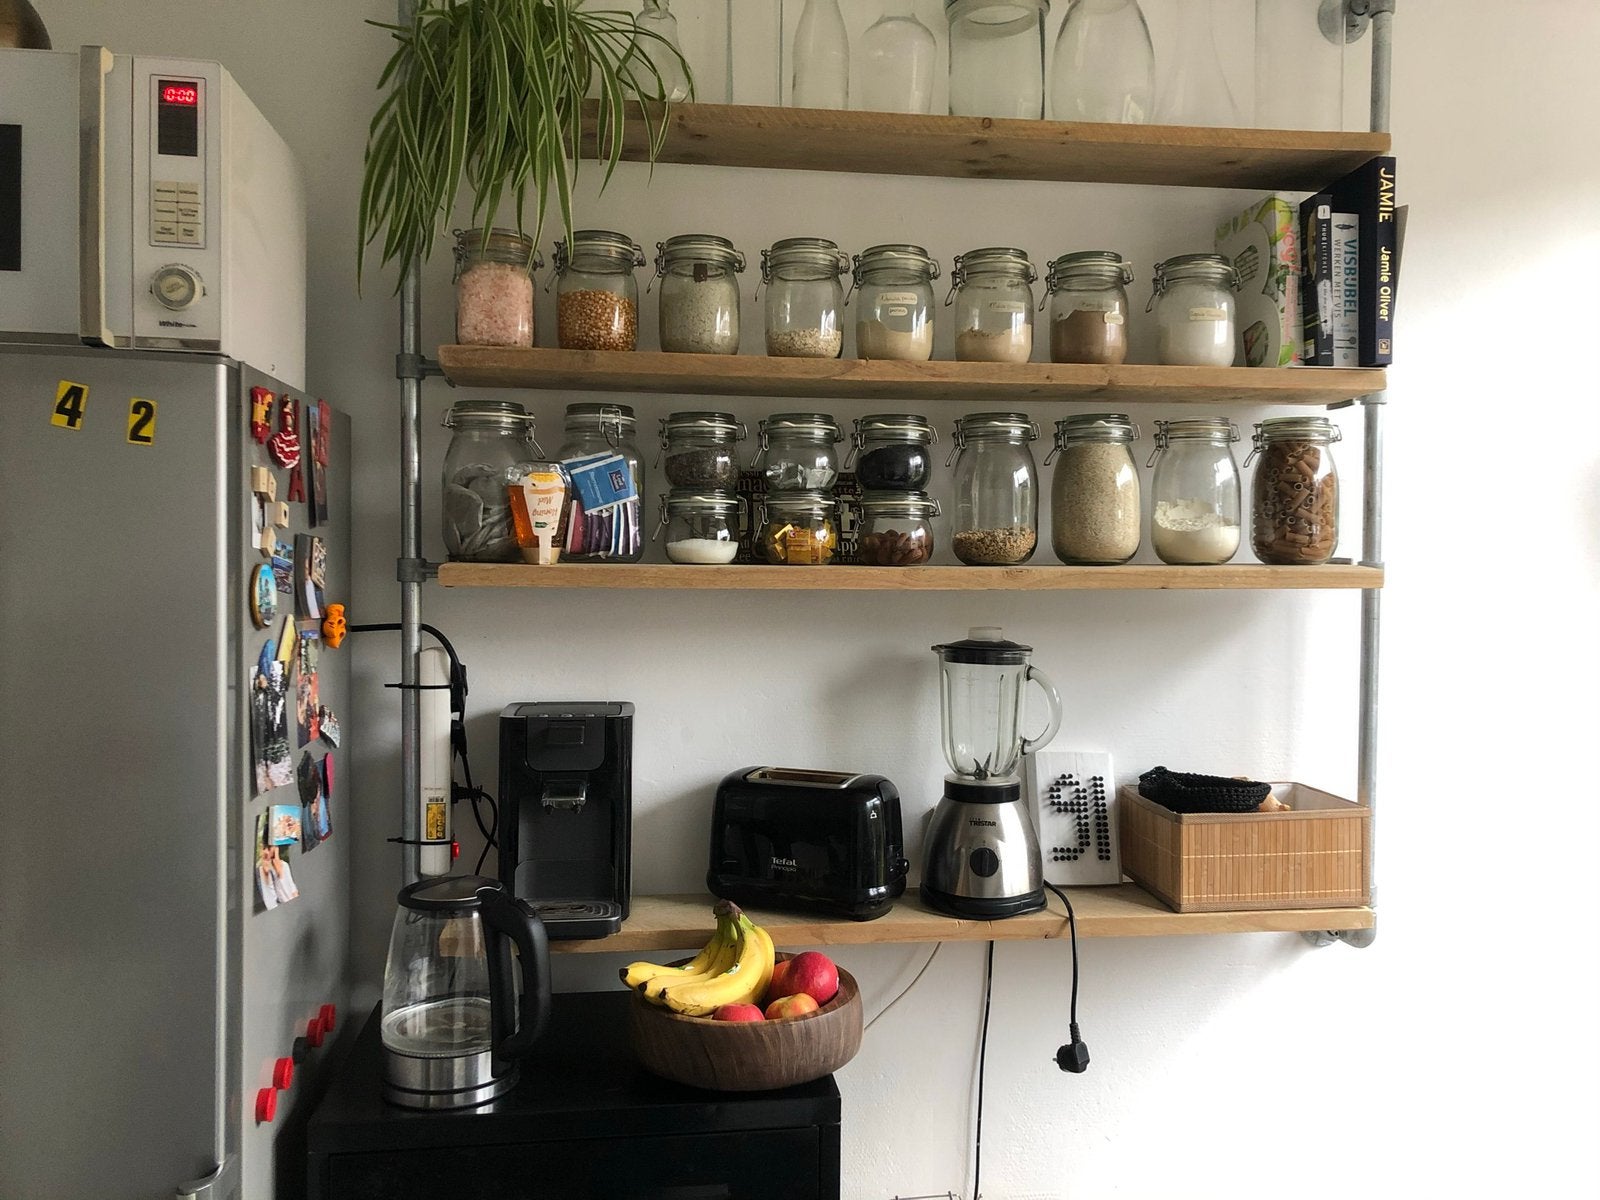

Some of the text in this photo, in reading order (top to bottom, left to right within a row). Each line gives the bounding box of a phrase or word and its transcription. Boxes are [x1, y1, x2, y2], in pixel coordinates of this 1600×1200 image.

[1378, 167, 1394, 223] JAMIE
[1334, 239, 1342, 319] WERKEN MET VIS
[1379, 246, 1392, 322] Jamie Oliver
[55, 384, 83, 427] 4
[129, 400, 153, 443] 2
[771, 856, 797, 867] Tefal
